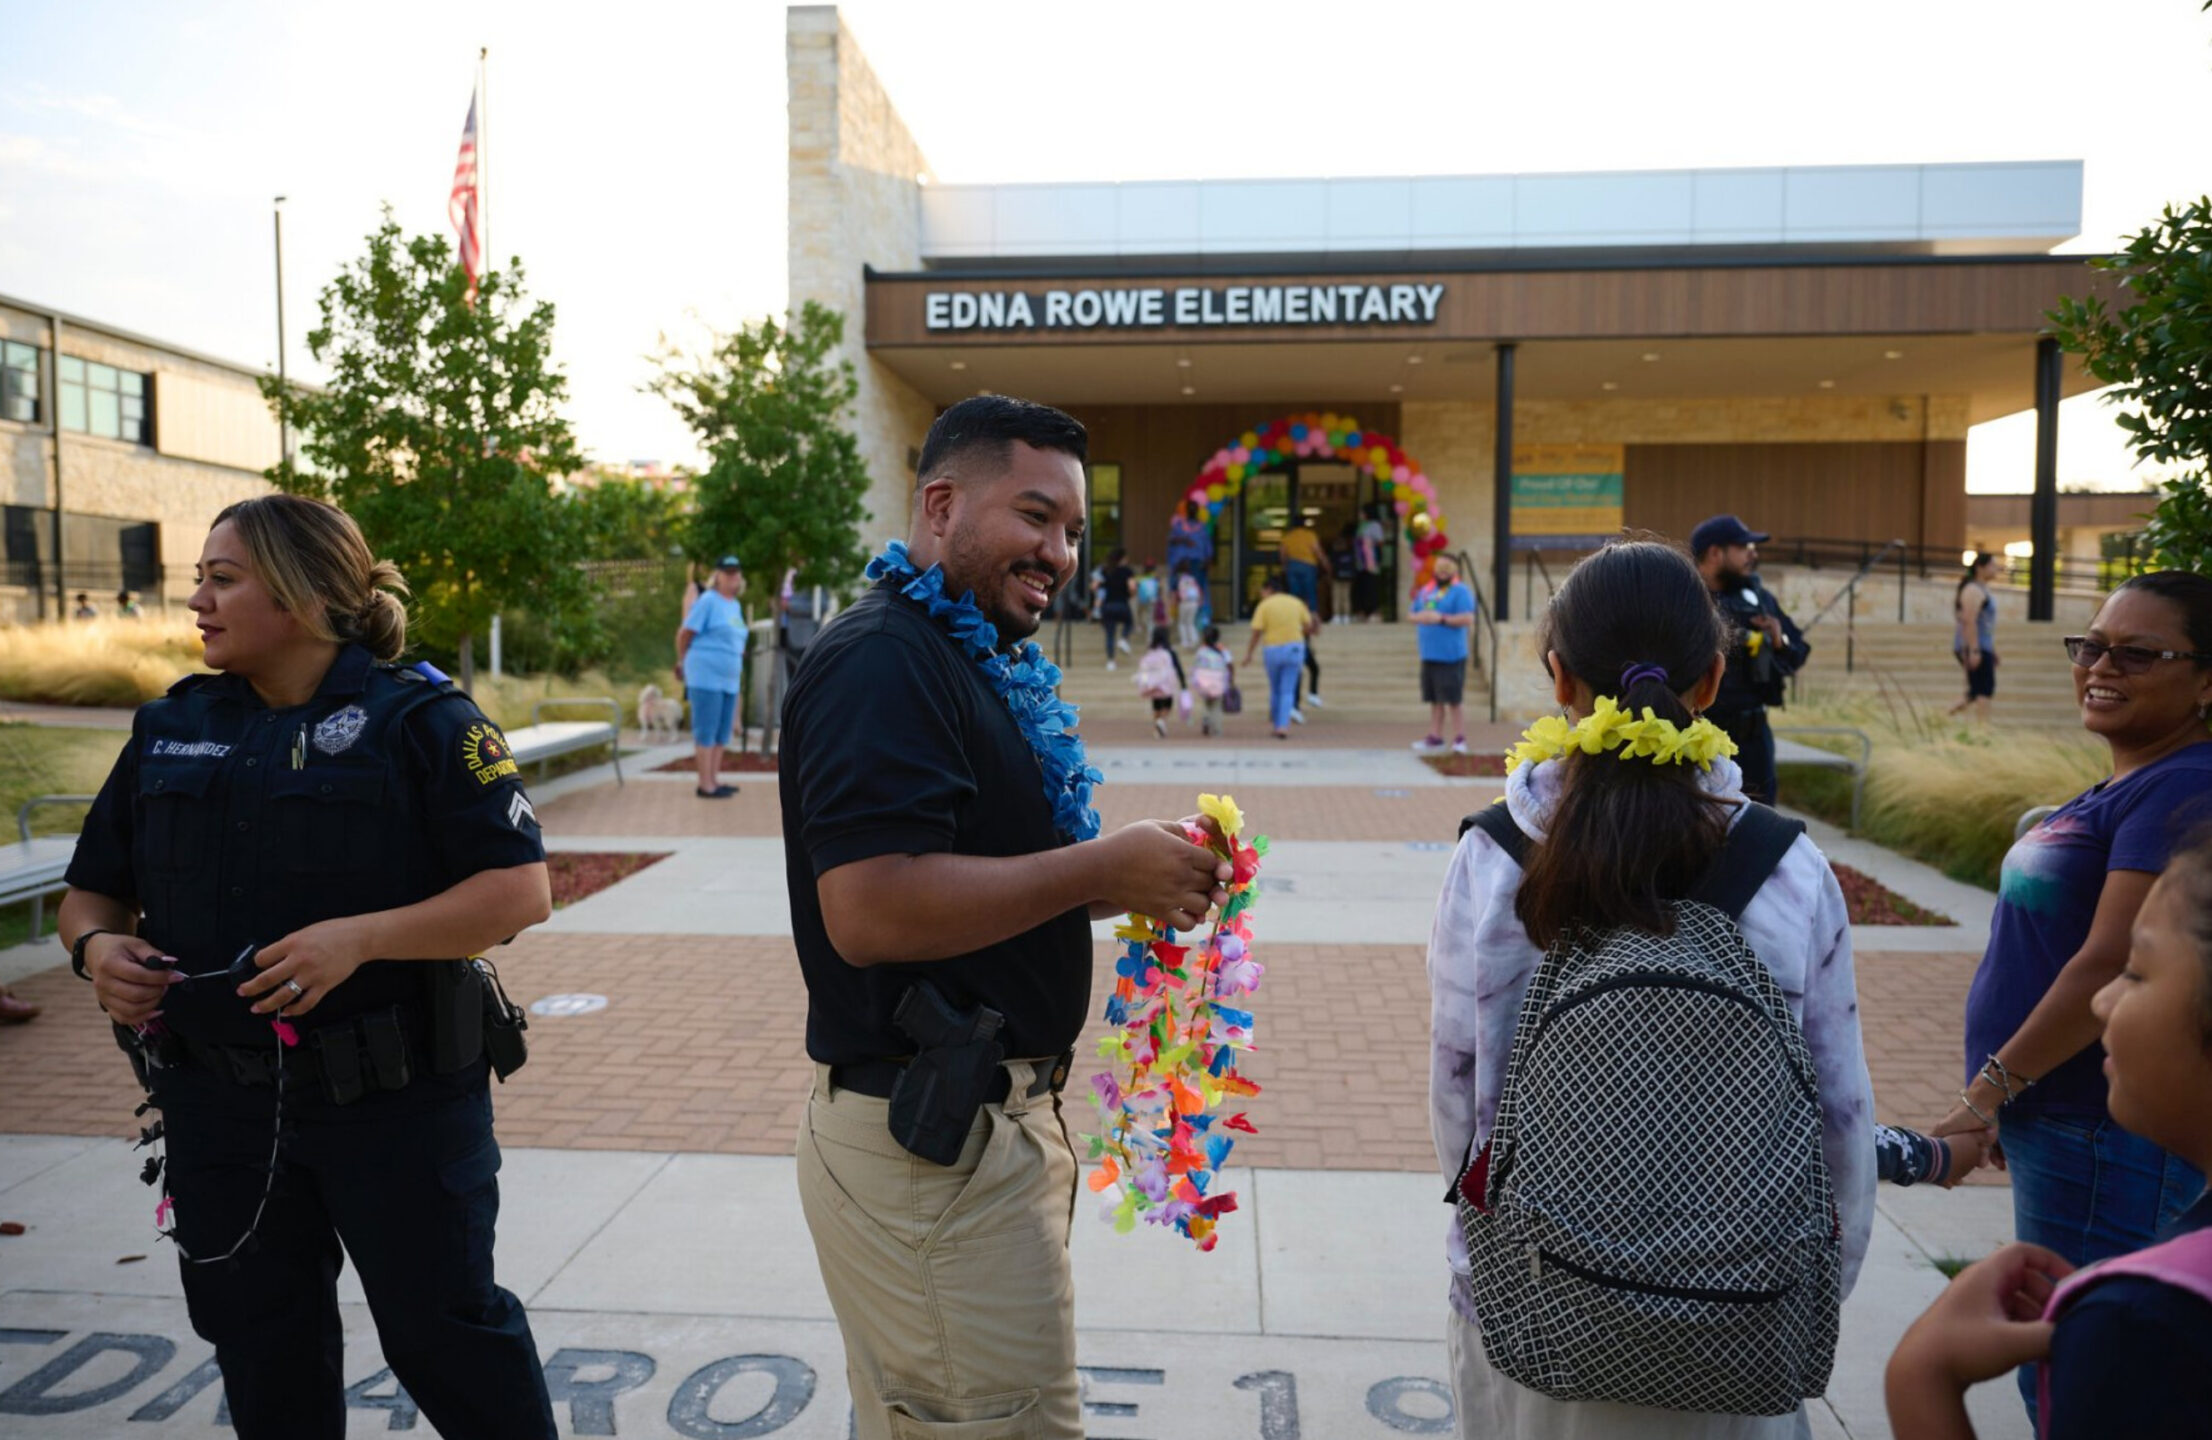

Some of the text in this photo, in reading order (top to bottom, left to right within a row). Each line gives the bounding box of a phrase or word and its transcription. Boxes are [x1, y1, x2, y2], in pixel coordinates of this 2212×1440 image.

[926, 284, 1444, 328] EDNA ROWE ELEMENTARY
[164, 741, 231, 757] HERNANDEZ
[462, 725, 484, 770] DALLAS
